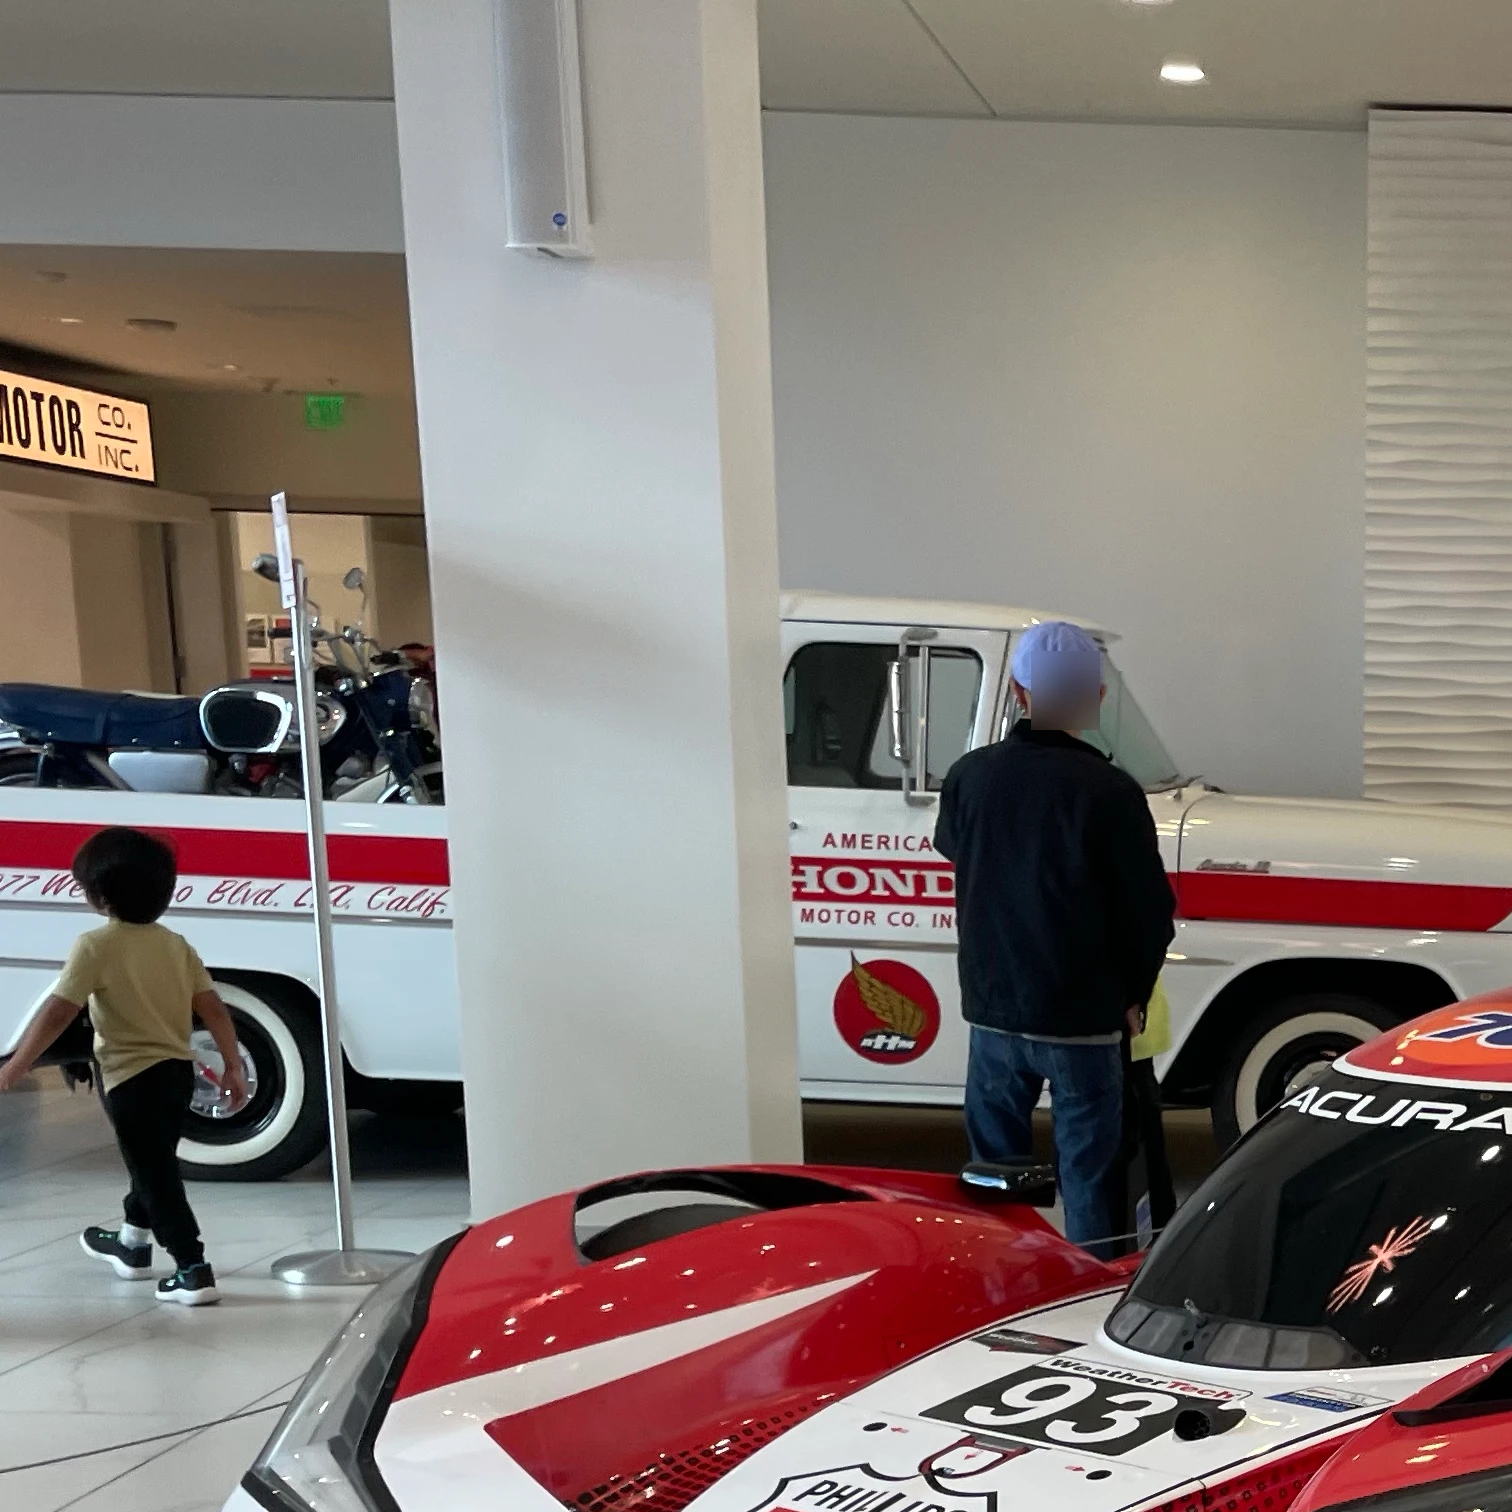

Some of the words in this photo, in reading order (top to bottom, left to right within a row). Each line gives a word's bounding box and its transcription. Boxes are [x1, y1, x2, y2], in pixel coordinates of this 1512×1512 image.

[97, 403, 132, 430] CO.
[98, 444, 139, 472] INC.
[823, 832, 933, 851] AMERICA
[792, 865, 955, 898] HOND
[207, 879, 285, 907] Blvd.
[367, 885, 449, 918] Calif.
[800, 908, 876, 926] MOTOR
[887, 912, 919, 928] CO.
[932, 913, 959, 928] IN
[1050, 1358, 1236, 1400] WeatherTech
[964, 1375, 1178, 1444] 93
